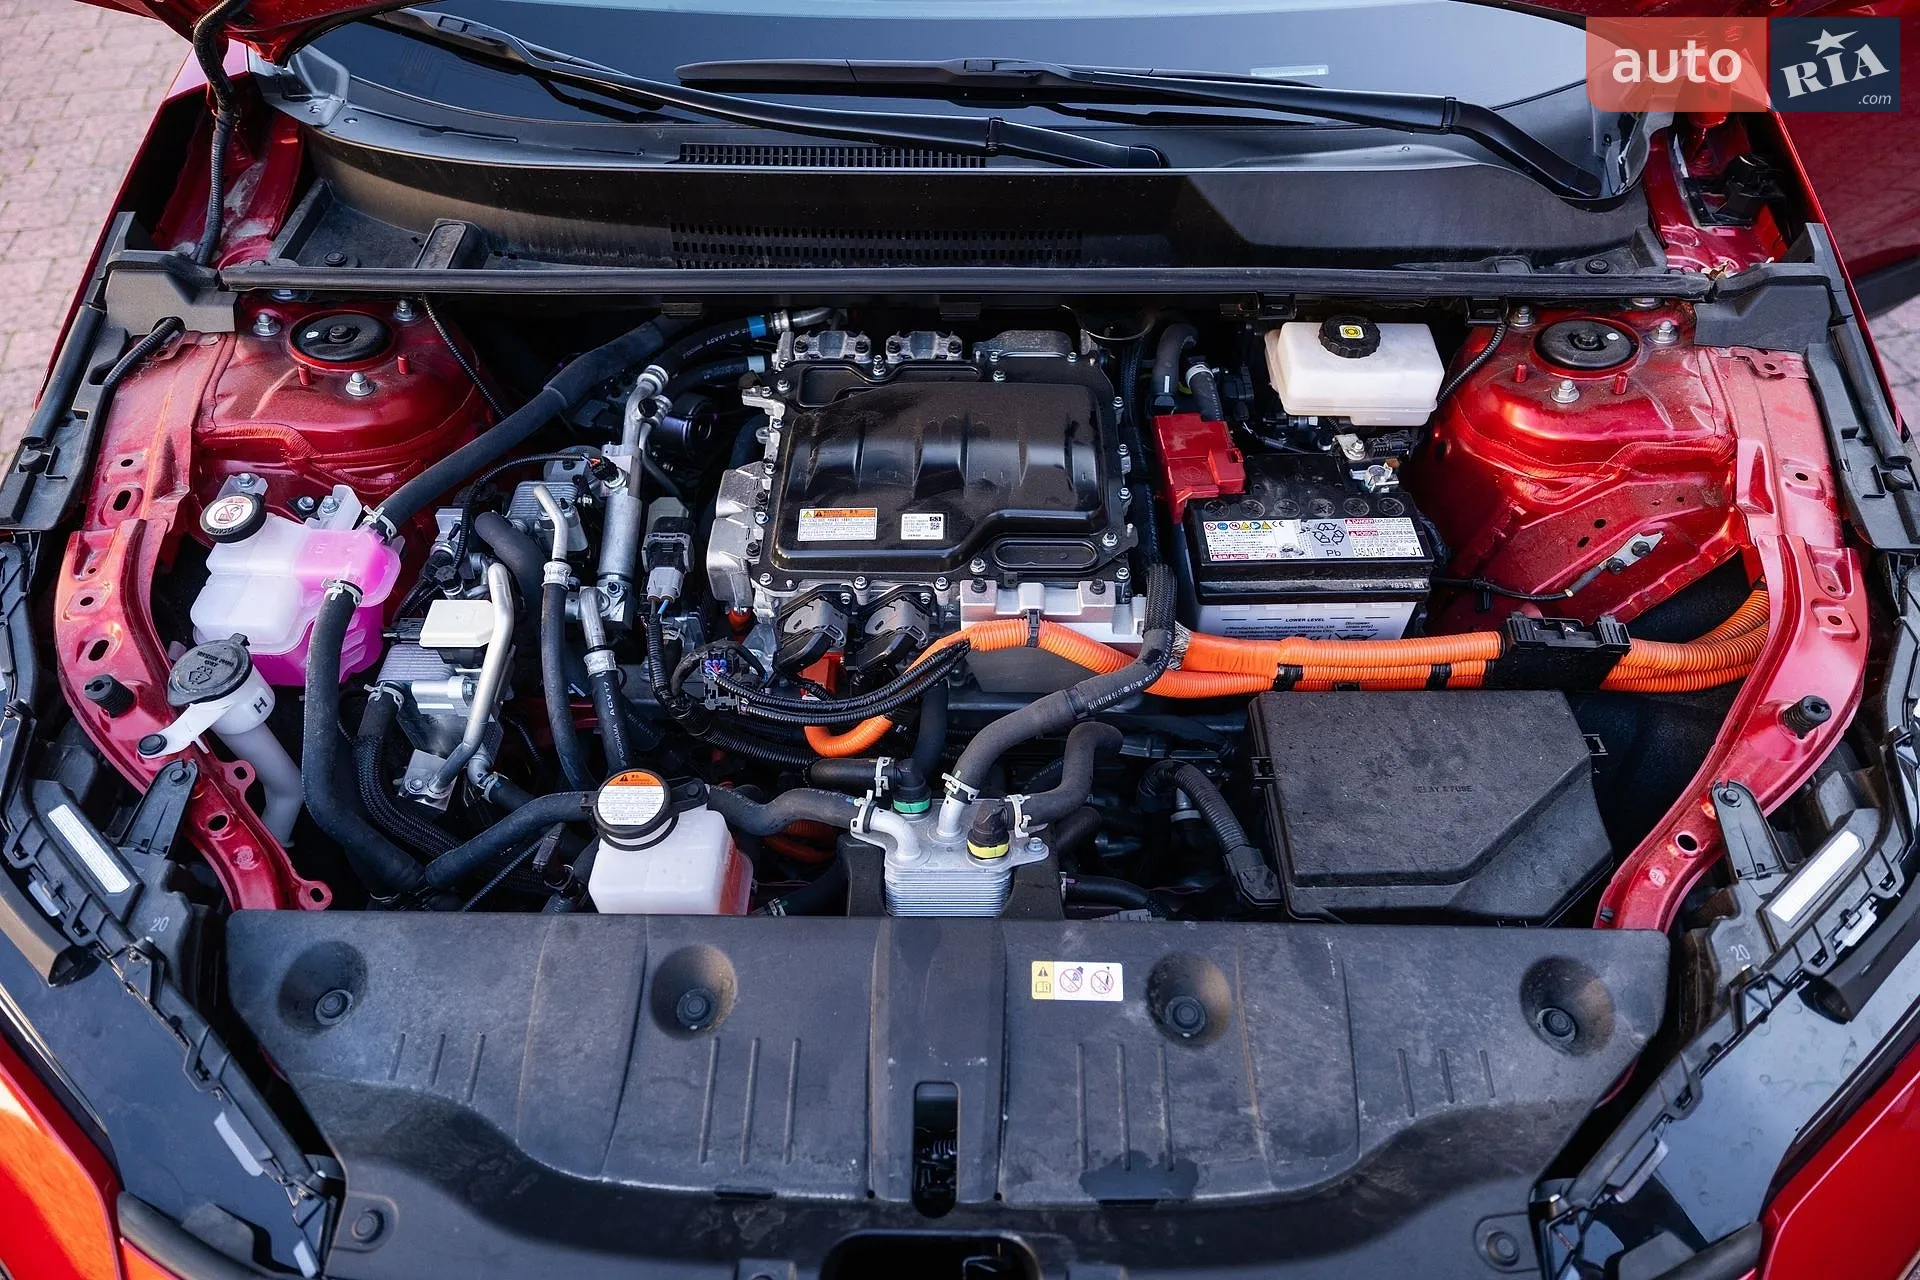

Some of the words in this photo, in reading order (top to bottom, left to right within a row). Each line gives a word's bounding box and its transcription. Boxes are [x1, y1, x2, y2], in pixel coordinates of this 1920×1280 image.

[1410, 547, 1423, 556] J1
[253, 696, 268, 713] H
[603, 681, 616, 716] ACV17
[612, 723, 625, 759] YOKOHAMA
[150, 915, 170, 931] 20
[1730, 944, 1751, 960] 20
